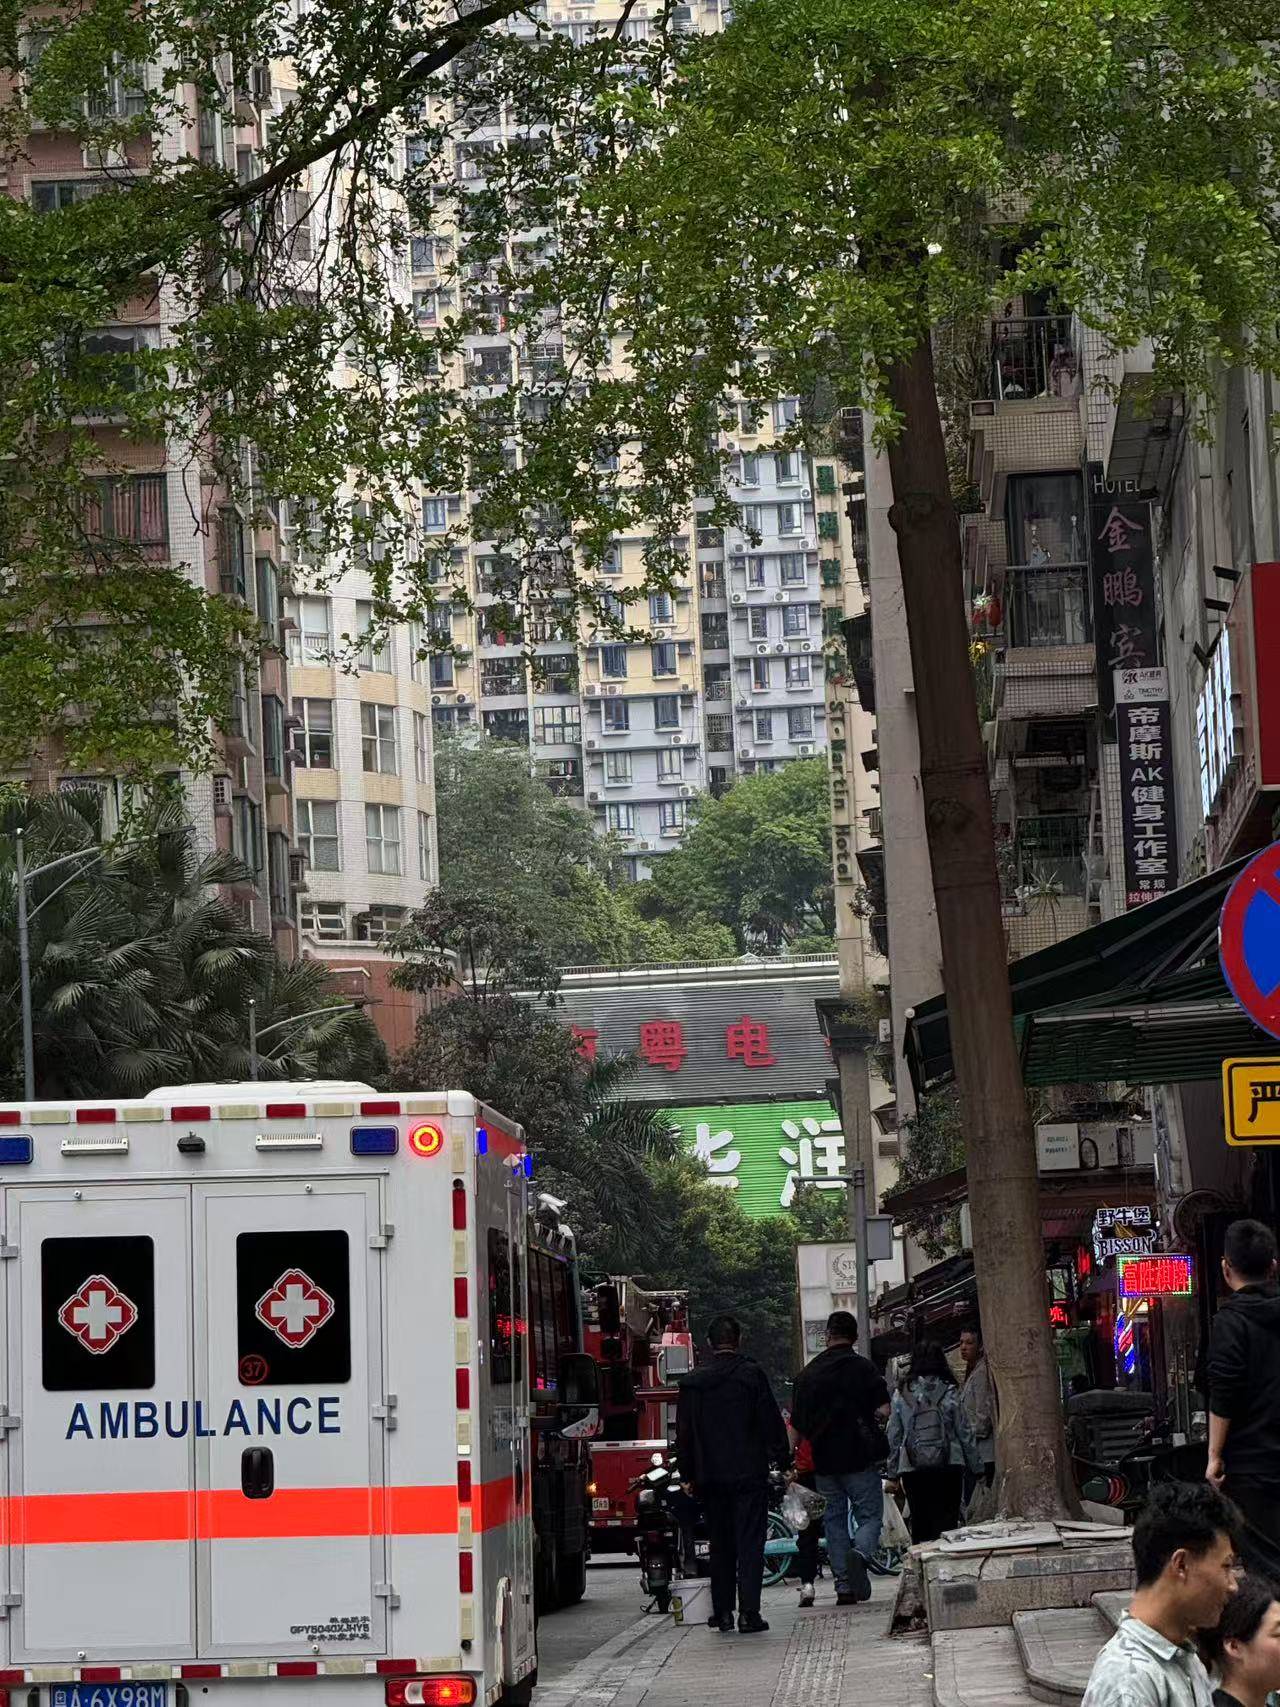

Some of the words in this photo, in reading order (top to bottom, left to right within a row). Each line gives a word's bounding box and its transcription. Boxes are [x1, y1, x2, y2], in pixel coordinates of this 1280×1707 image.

[1098, 506, 1147, 719] 金鹏宾
[836, 825, 852, 882] Hotel
[1096, 1206, 1151, 1226] 野牛堡
[1097, 1237, 1152, 1258] BISSON
[244, 1361, 262, 1377] 37
[65, 1397, 341, 1440] AMBULANCE
